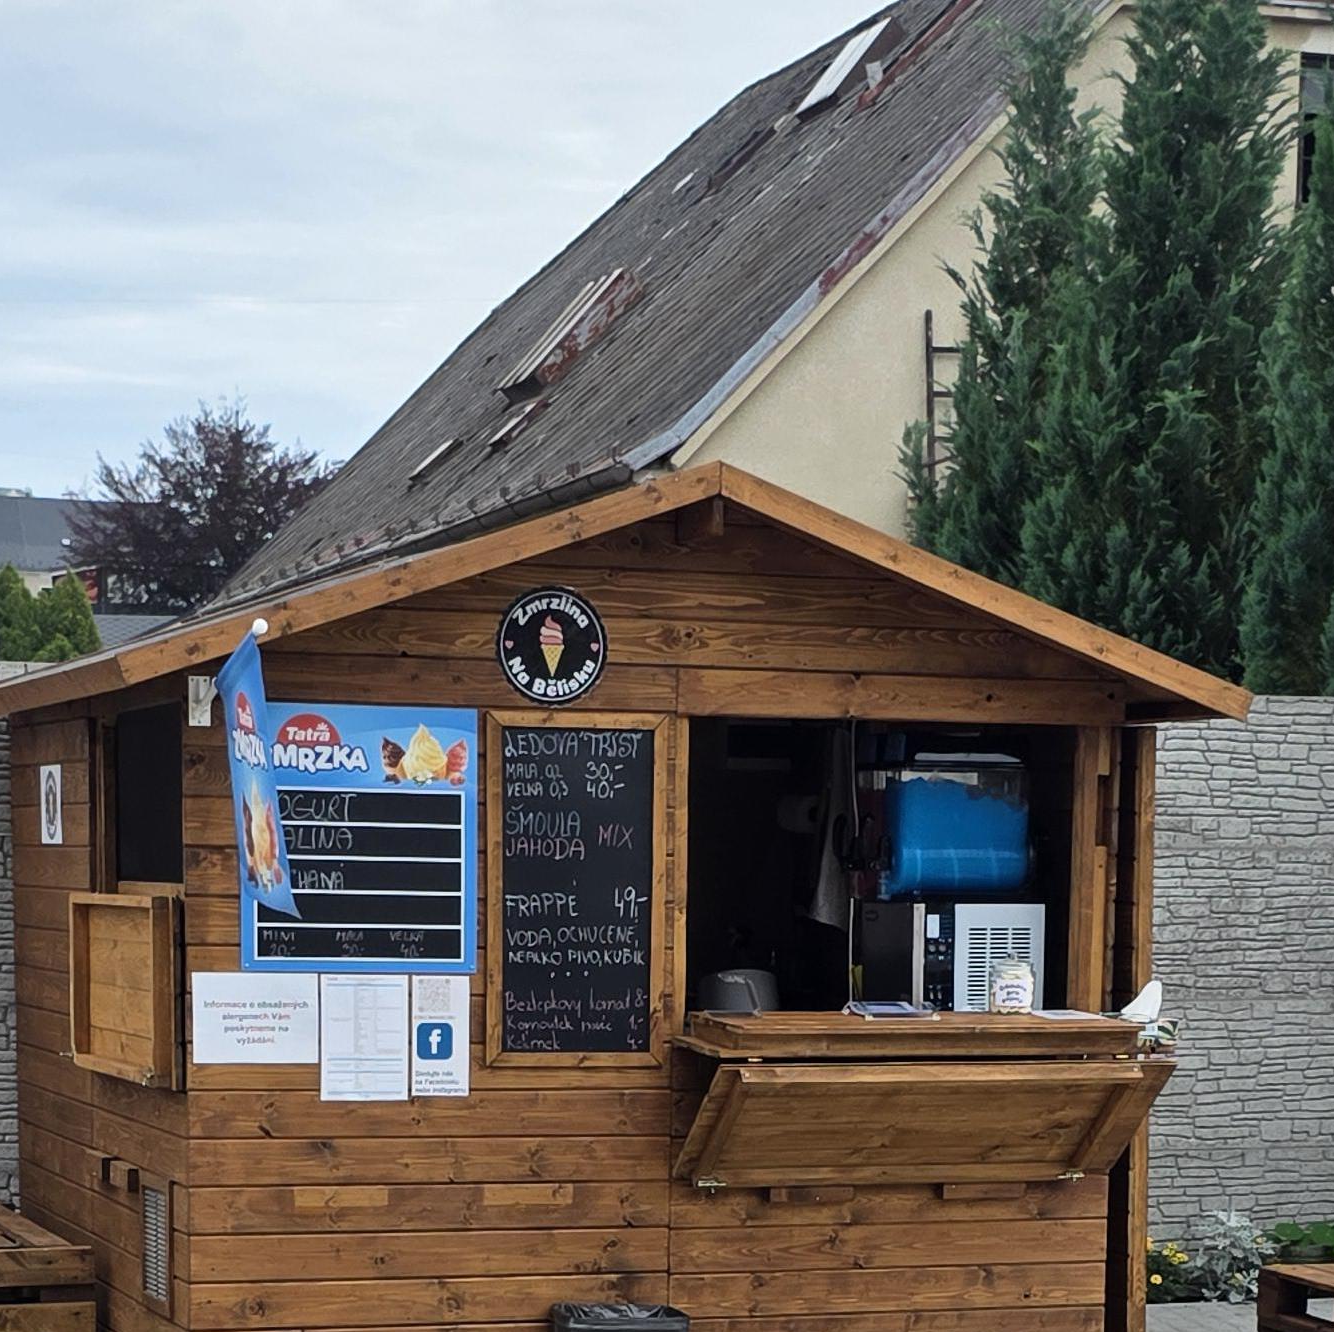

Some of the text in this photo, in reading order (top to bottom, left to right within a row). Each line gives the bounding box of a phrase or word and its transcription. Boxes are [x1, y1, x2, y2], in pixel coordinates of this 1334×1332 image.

[512, 596, 589, 628] Zmrzlina
[508, 656, 530, 685] Na
[286, 725, 331, 742] Tatra
[270, 743, 370, 774] MRZKA
[278, 792, 358, 821] OGURT
[505, 803, 581, 838] ŠMOULA
[283, 826, 353, 850] ALINA
[505, 837, 585, 861] JAHODA
[598, 823, 635, 850] MIX
